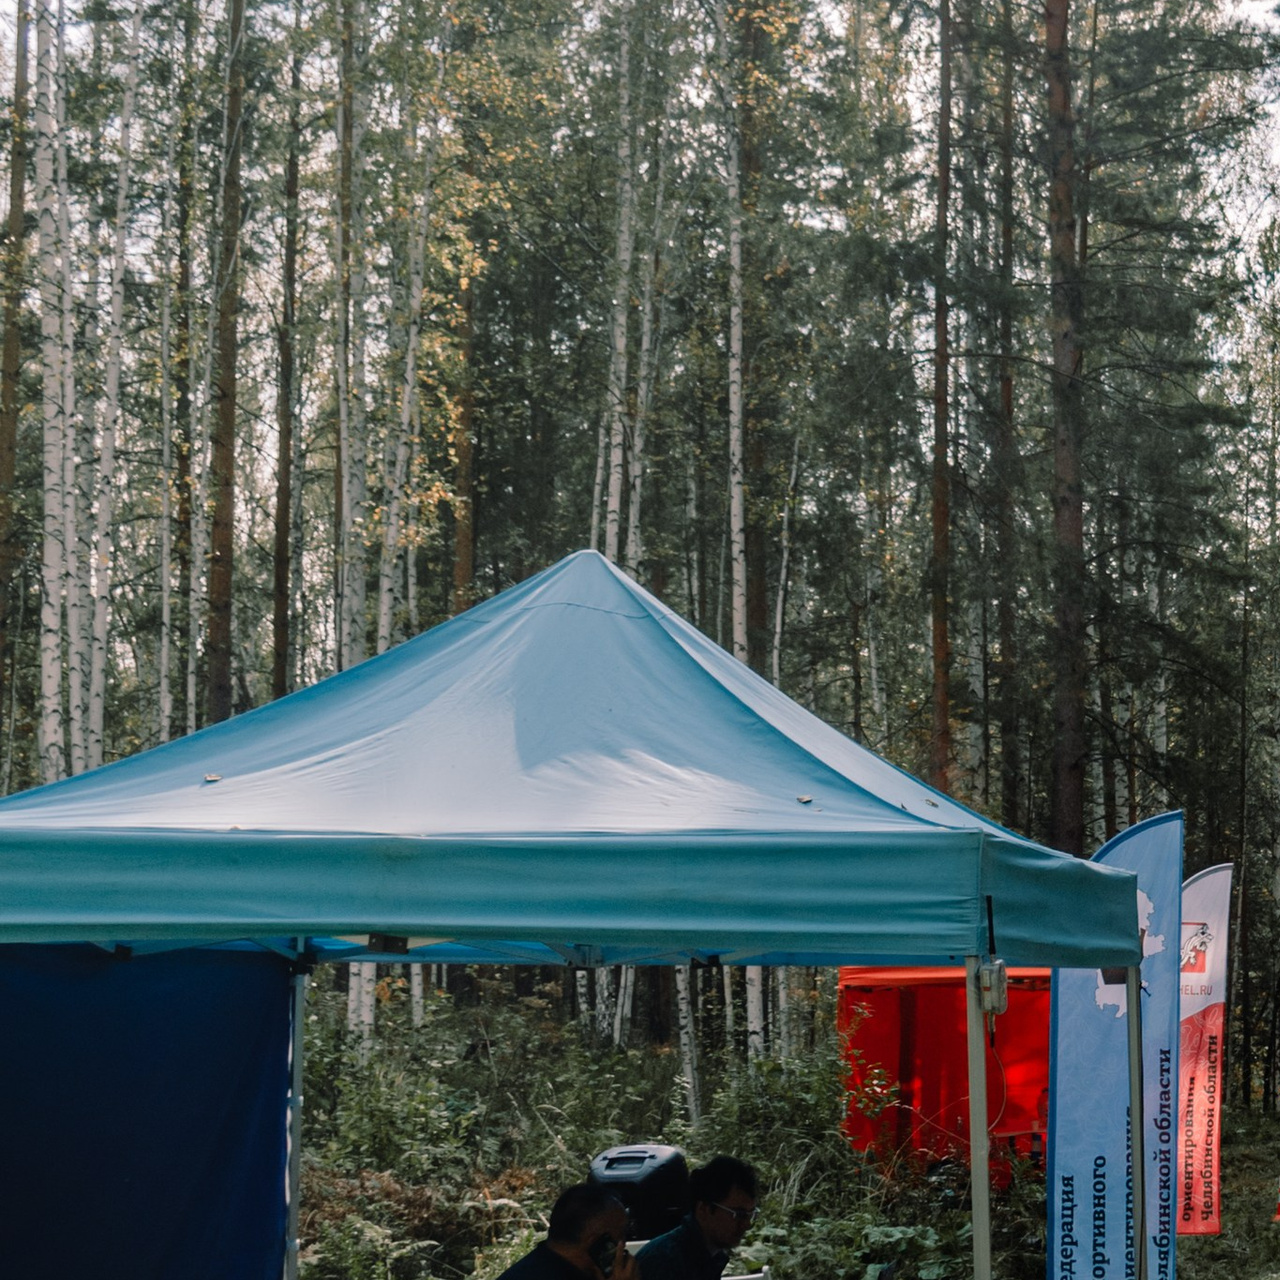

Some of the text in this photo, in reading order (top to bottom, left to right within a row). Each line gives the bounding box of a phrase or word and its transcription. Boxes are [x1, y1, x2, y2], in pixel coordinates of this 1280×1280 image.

[1153, 1048, 1171, 1144] области
[1182, 1076, 1197, 1222] ориентирования
[1201, 1035, 1218, 1221] Челябинской области
